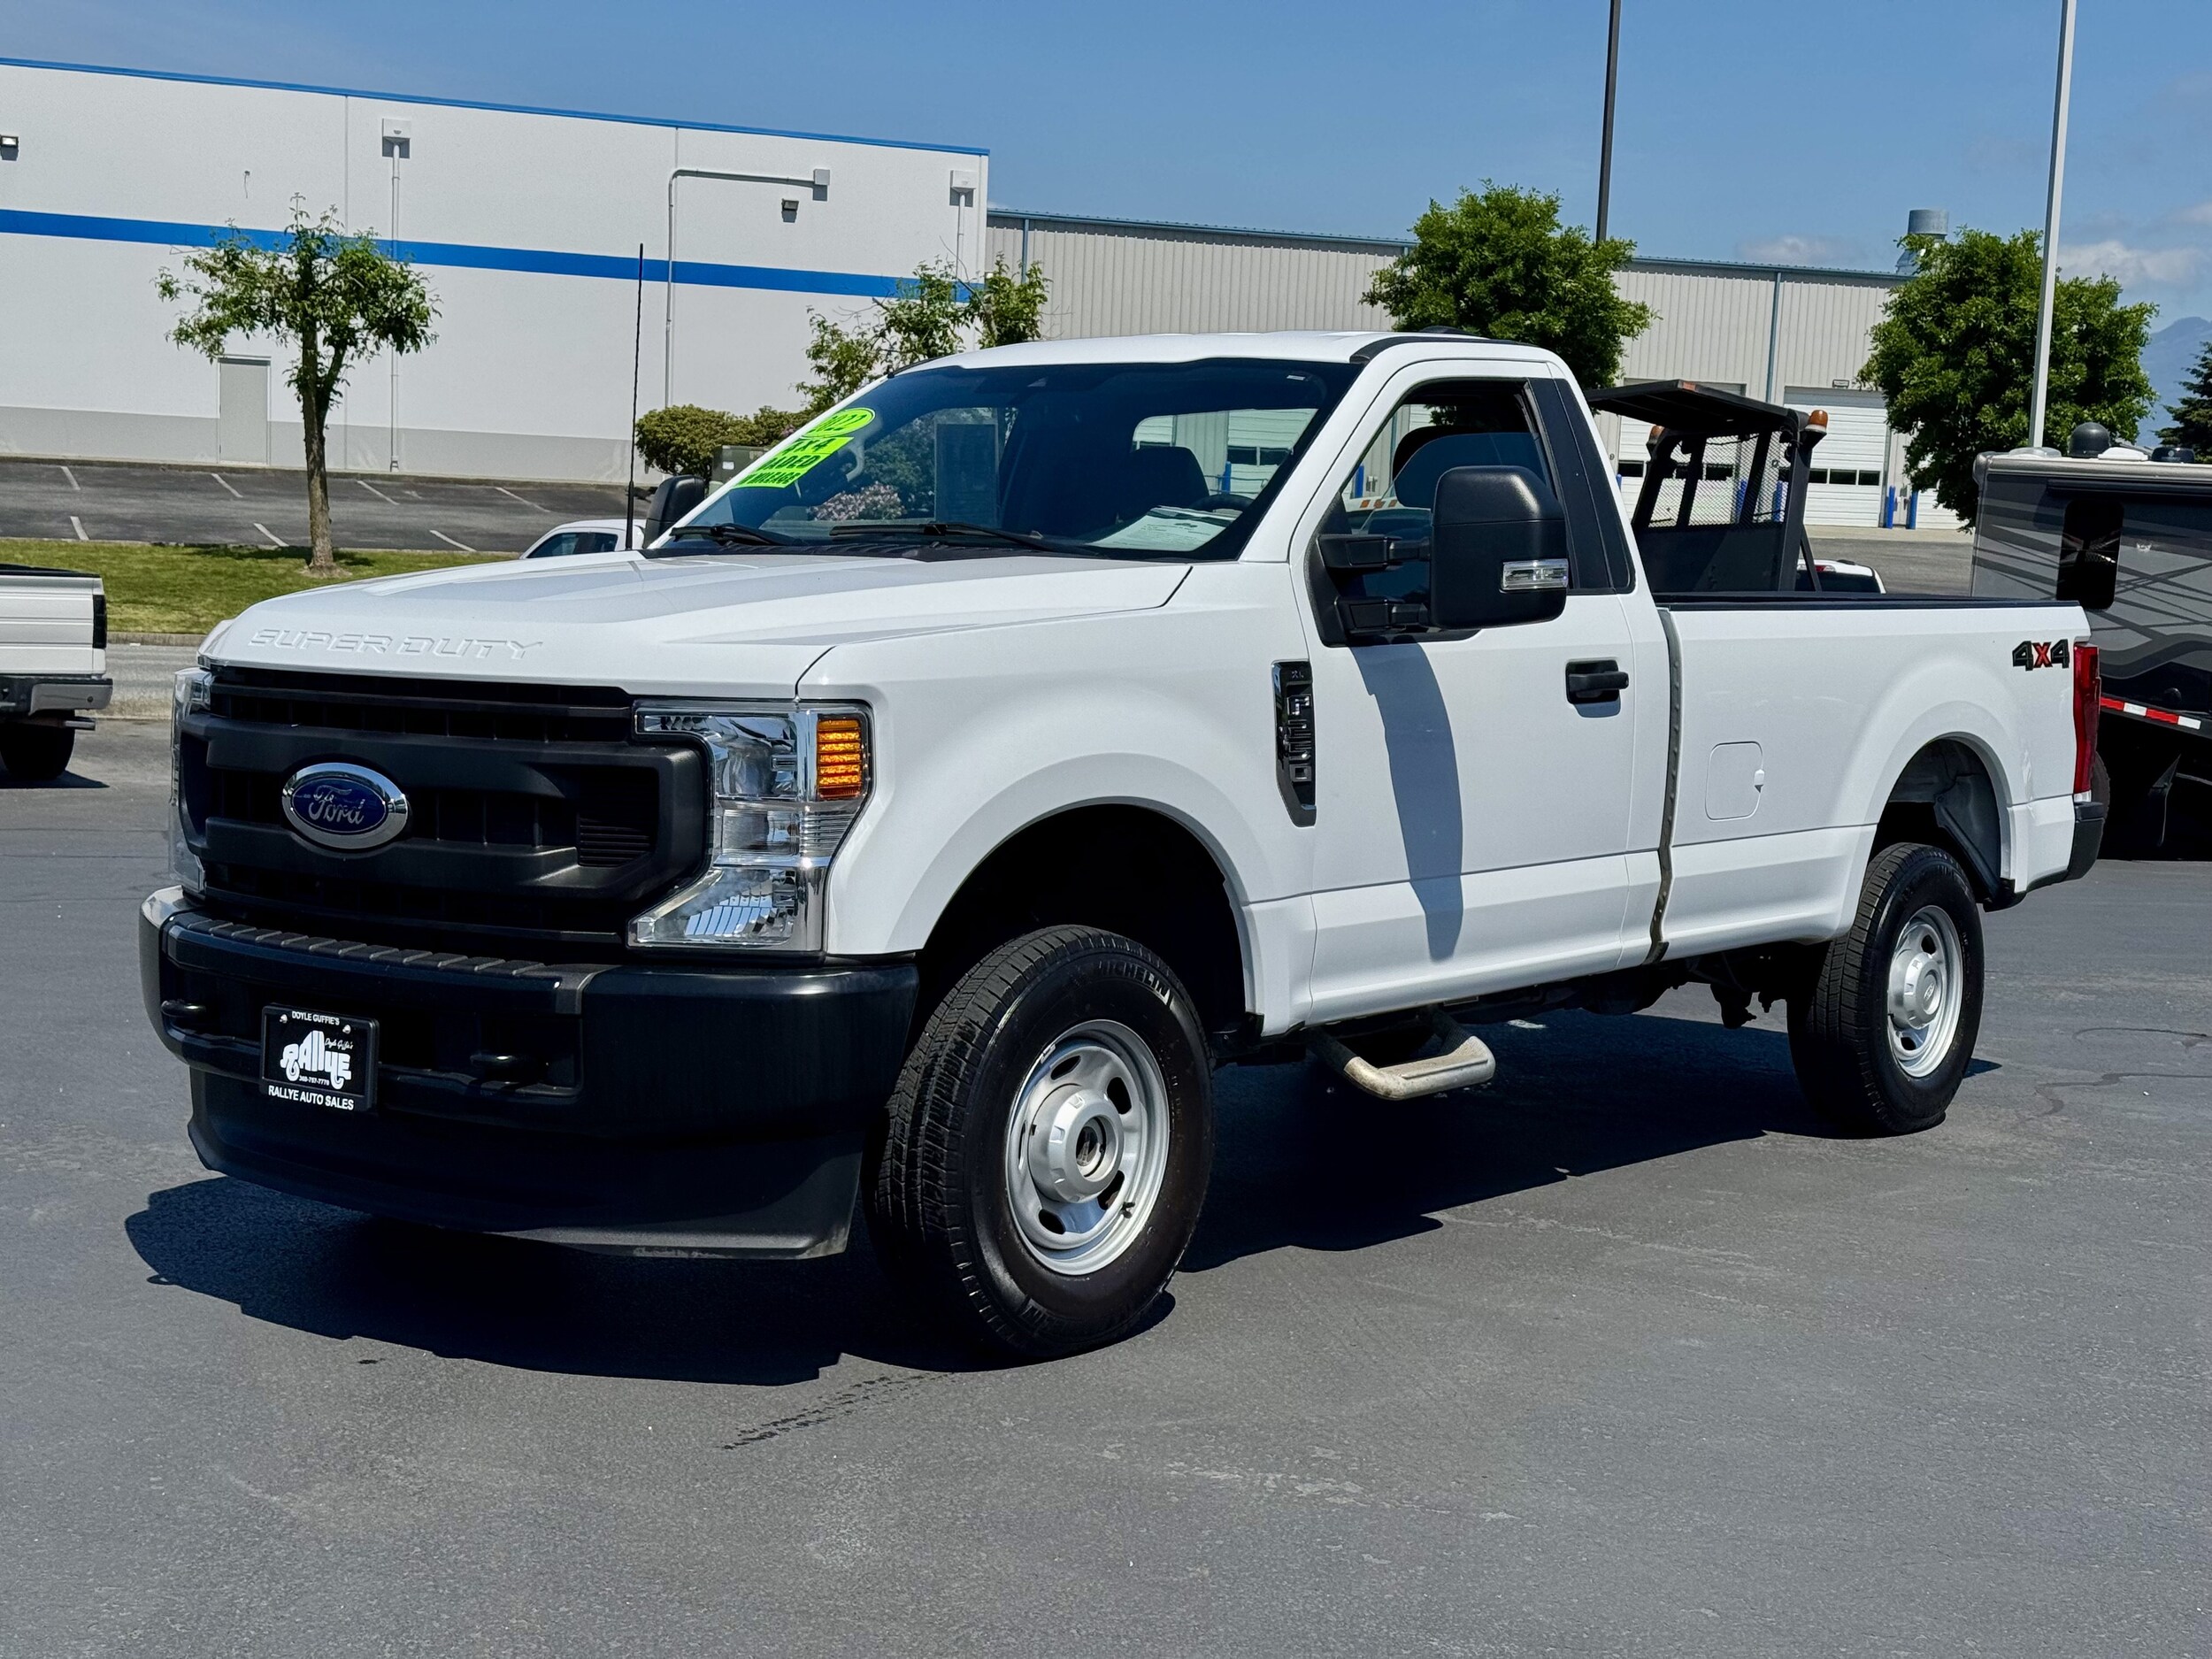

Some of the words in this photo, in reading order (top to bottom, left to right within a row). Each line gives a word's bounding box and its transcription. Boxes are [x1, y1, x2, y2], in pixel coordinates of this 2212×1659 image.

[248, 628, 394, 654] SUPER
[396, 636, 544, 660] DUTY
[308, 784, 365, 825] Ford
[291, 1010, 312, 1022] DOYLE
[312, 1014, 341, 1026] GUFFIE'S
[268, 1085, 300, 1101] RALLYE
[300, 1091, 324, 1105] AUTO
[325, 1094, 355, 1110] SALES
